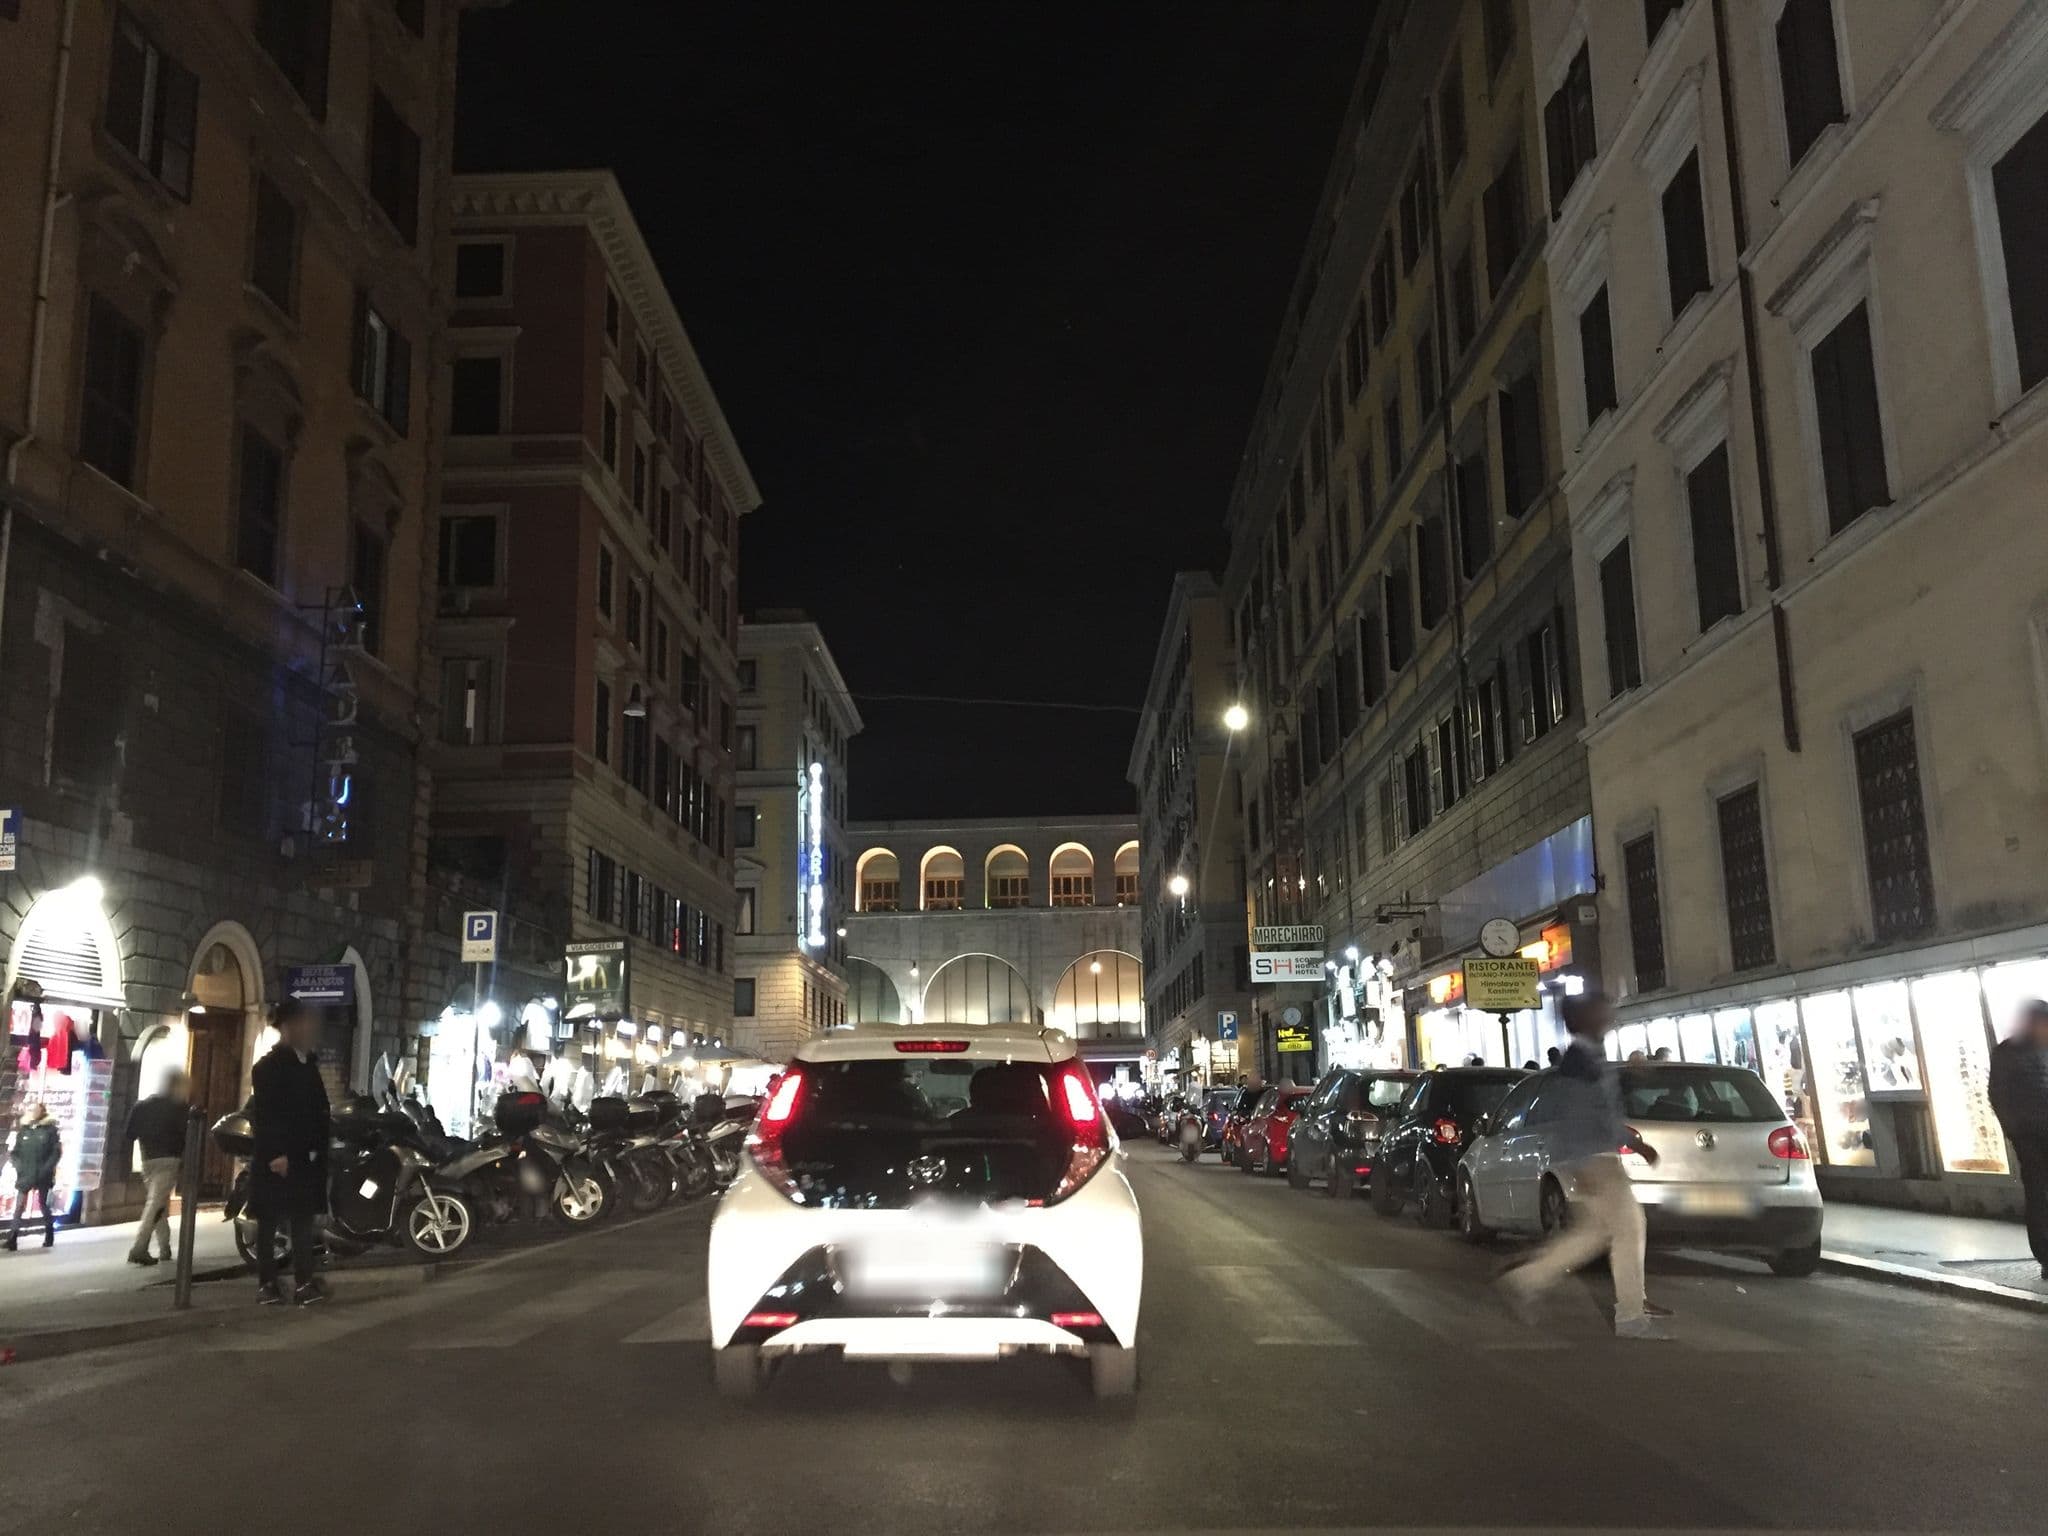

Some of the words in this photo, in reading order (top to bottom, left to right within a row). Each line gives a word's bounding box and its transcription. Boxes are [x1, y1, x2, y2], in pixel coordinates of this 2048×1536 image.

[473, 919, 487, 937] P
[1254, 926, 1323, 943] MARECHIARO
[302, 967, 337, 976] HOTEL
[1468, 961, 1536, 972] RISTORANTE
[1222, 1013, 1234, 1028] P
